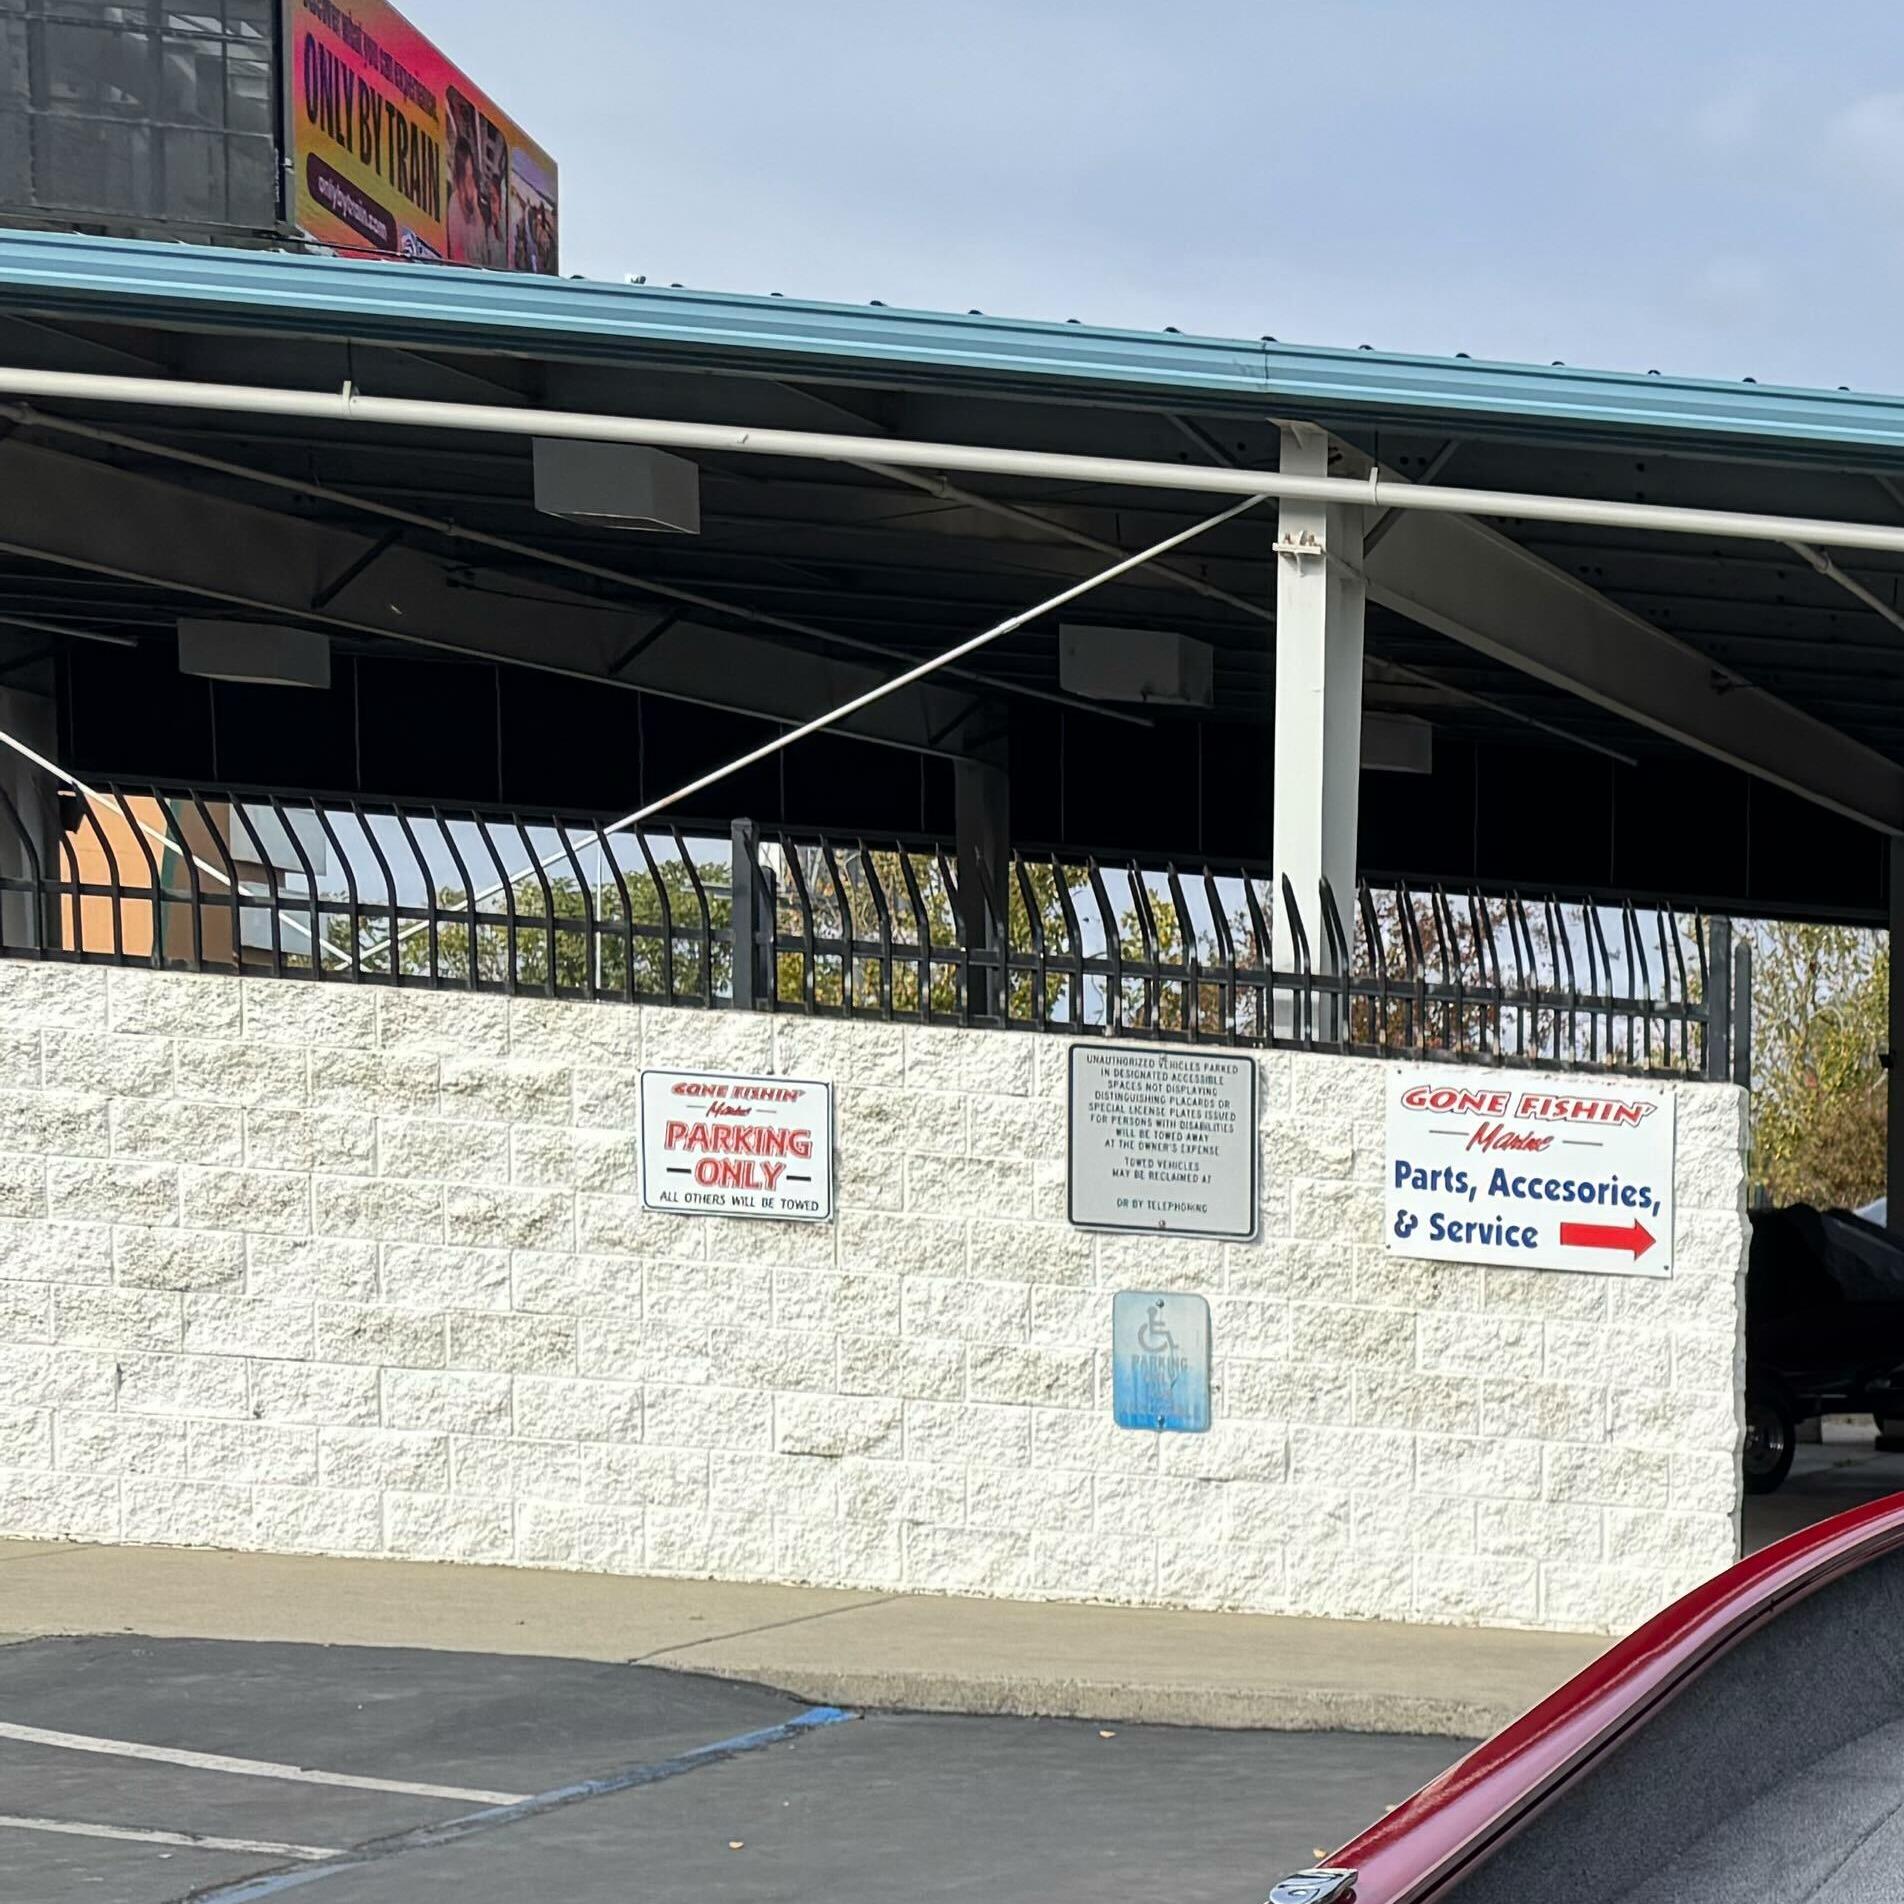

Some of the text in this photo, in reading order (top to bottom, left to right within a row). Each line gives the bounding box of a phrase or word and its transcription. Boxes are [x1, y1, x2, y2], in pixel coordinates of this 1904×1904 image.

[304, 32, 441, 224] ONLY BY TRAIN
[318, 176, 388, 242] onlybytrain.com
[1086, 1055, 1239, 1074] UNAUTHORIZED VEHICLES PARKED
[1101, 1068, 1224, 1086] IN DESIGNATED ACCESSIBLE
[672, 1082, 729, 1097] GONE
[1107, 1080, 1218, 1096] SPACES NOT DISPLAYING
[1095, 1091, 1230, 1109] DISTINGUISHING PLACARDS OR
[1401, 1085, 1657, 1127] GONE FISHIN'
[1088, 1103, 1236, 1122] SPECIAL LICENSE PLATES ISSUED
[1090, 1114, 1234, 1133] FOR PERSONS WITH DISABILITIES
[665, 1120, 812, 1159] PARKING
[1116, 1128, 1209, 1142] WILL BE TOWED AWAY
[1466, 1122, 1554, 1152] Marine
[1104, 1139, 1220, 1156] AT THE OWNER'S EXPENSE
[1124, 1157, 1200, 1171] TOWED VEHICLES
[694, 1157, 786, 1191] ONLY
[1112, 1169, 1212, 1184] MAY BE RECLAIMED AT
[1395, 1160, 1661, 1217] Parts, Accesories,
[660, 1192, 818, 1211] ALL OTHERS WILL BE TOWED
[1116, 1198, 1208, 1213] OR BY TELEPHONING
[1394, 1210, 1538, 1249] & Service
